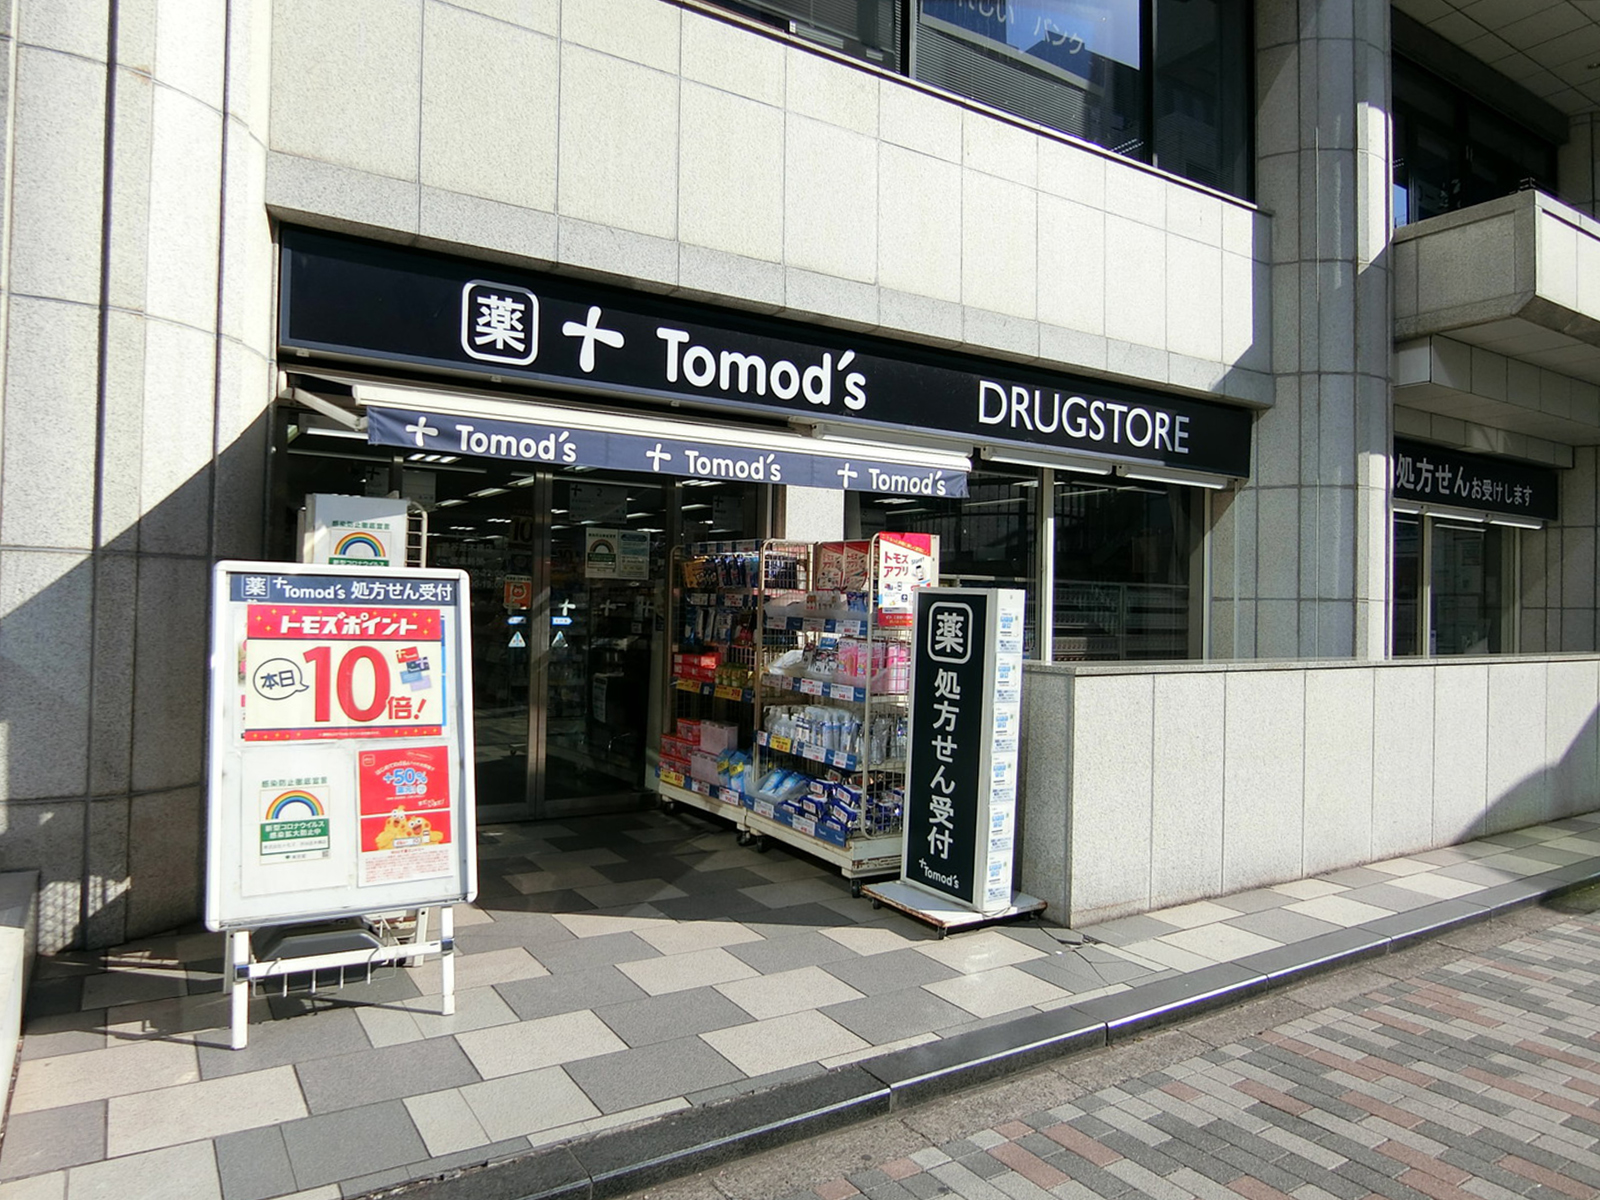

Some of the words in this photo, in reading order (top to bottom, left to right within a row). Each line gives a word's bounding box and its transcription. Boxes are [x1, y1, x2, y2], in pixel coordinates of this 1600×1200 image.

[474, 294, 526, 352] 薬
[656, 326, 867, 411] Tomod's
[978, 379, 1190, 454] DRUGSTORE
[455, 424, 577, 463] Tomod's
[684, 450, 782, 482] Tomod's
[868, 468, 946, 495] Tomod's
[1396, 453, 1533, 507] 処方せんお受けします
[884, 551, 909, 565] トモズ
[883, 566, 909, 578] アプリ
[245, 576, 266, 595] 薬
[282, 584, 346, 599] Tomod's
[350, 581, 453, 601] 処方せん受付
[280, 611, 418, 636] トモズポイント
[934, 612, 964, 653] 薬
[260, 669, 296, 690] 本日
[927, 668, 961, 859] 処方せん受付
[923, 866, 959, 889] Tomod's
